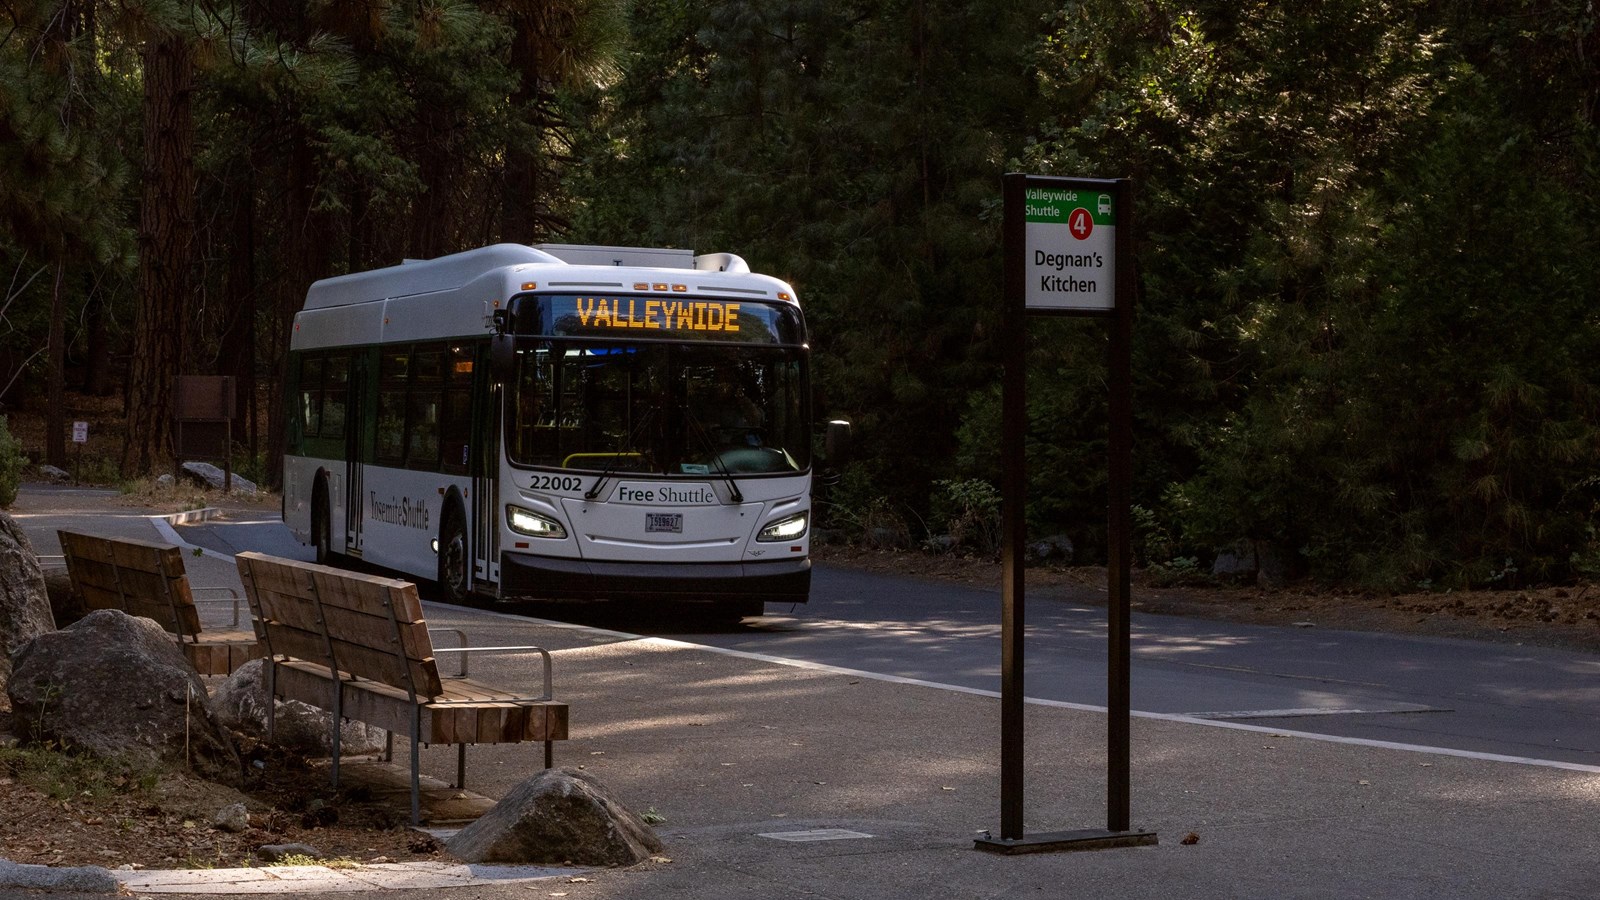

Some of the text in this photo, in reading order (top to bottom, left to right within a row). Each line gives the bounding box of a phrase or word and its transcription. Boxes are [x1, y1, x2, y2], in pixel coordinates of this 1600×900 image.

[1026, 189, 1078, 203] Valleywide
[1026, 205, 1060, 217] Shuttle
[1074, 213, 1086, 235] 4
[1035, 250, 1103, 271] Degnan's
[1041, 275, 1097, 293] Kitchen
[577, 297, 740, 332] VALLEYWIDE
[530, 475, 582, 492] 22002
[619, 487, 714, 503] Free Shuttle
